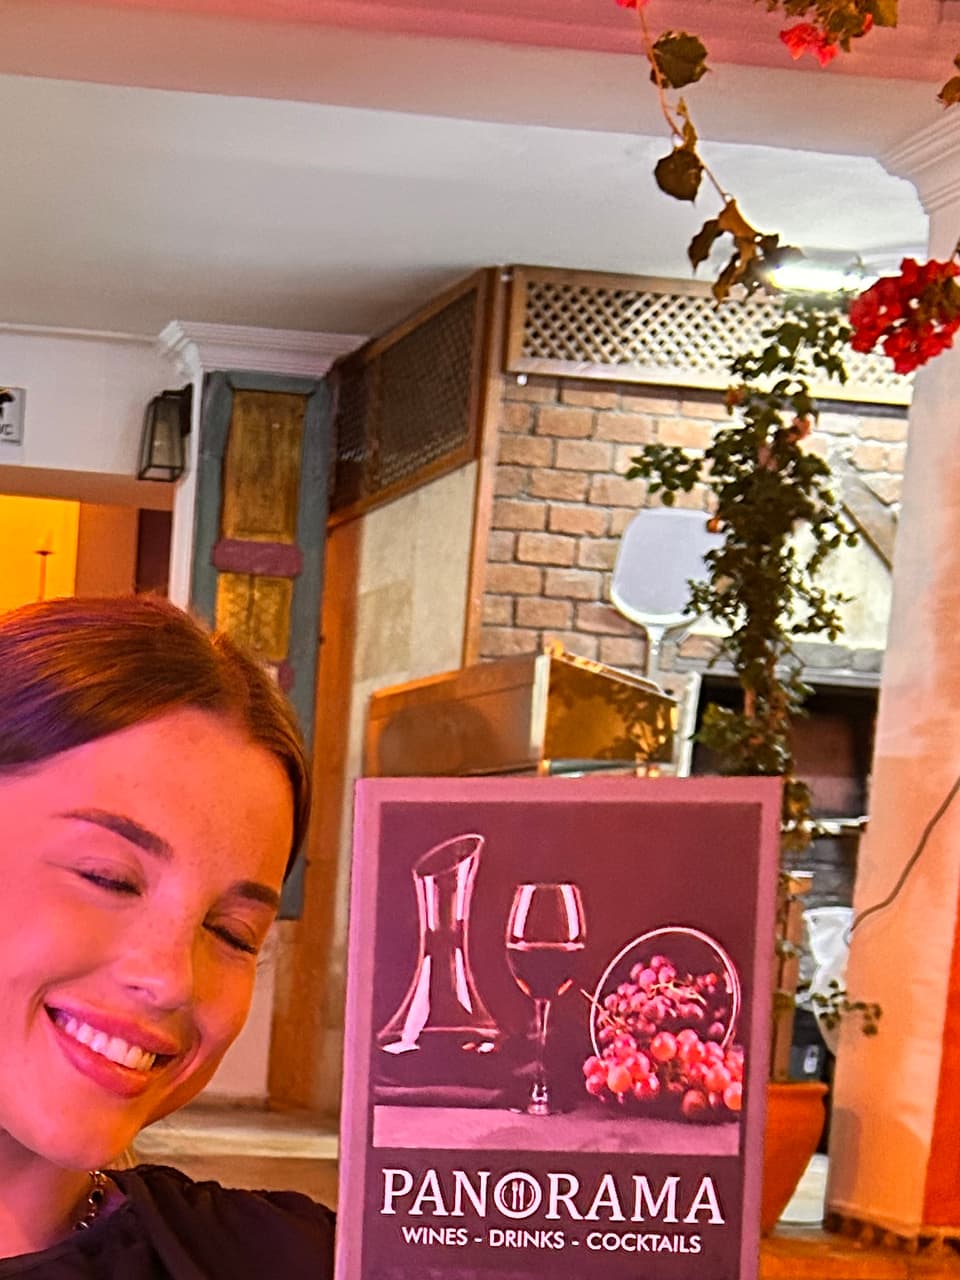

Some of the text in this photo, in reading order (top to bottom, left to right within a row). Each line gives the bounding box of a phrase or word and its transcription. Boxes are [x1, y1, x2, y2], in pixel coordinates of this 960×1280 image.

[380, 1168, 726, 1225] PANORAMA
[402, 1226, 469, 1247] WINES
[489, 1229, 566, 1250] DRINKS
[586, 1232, 702, 1254] COCKTAILS
